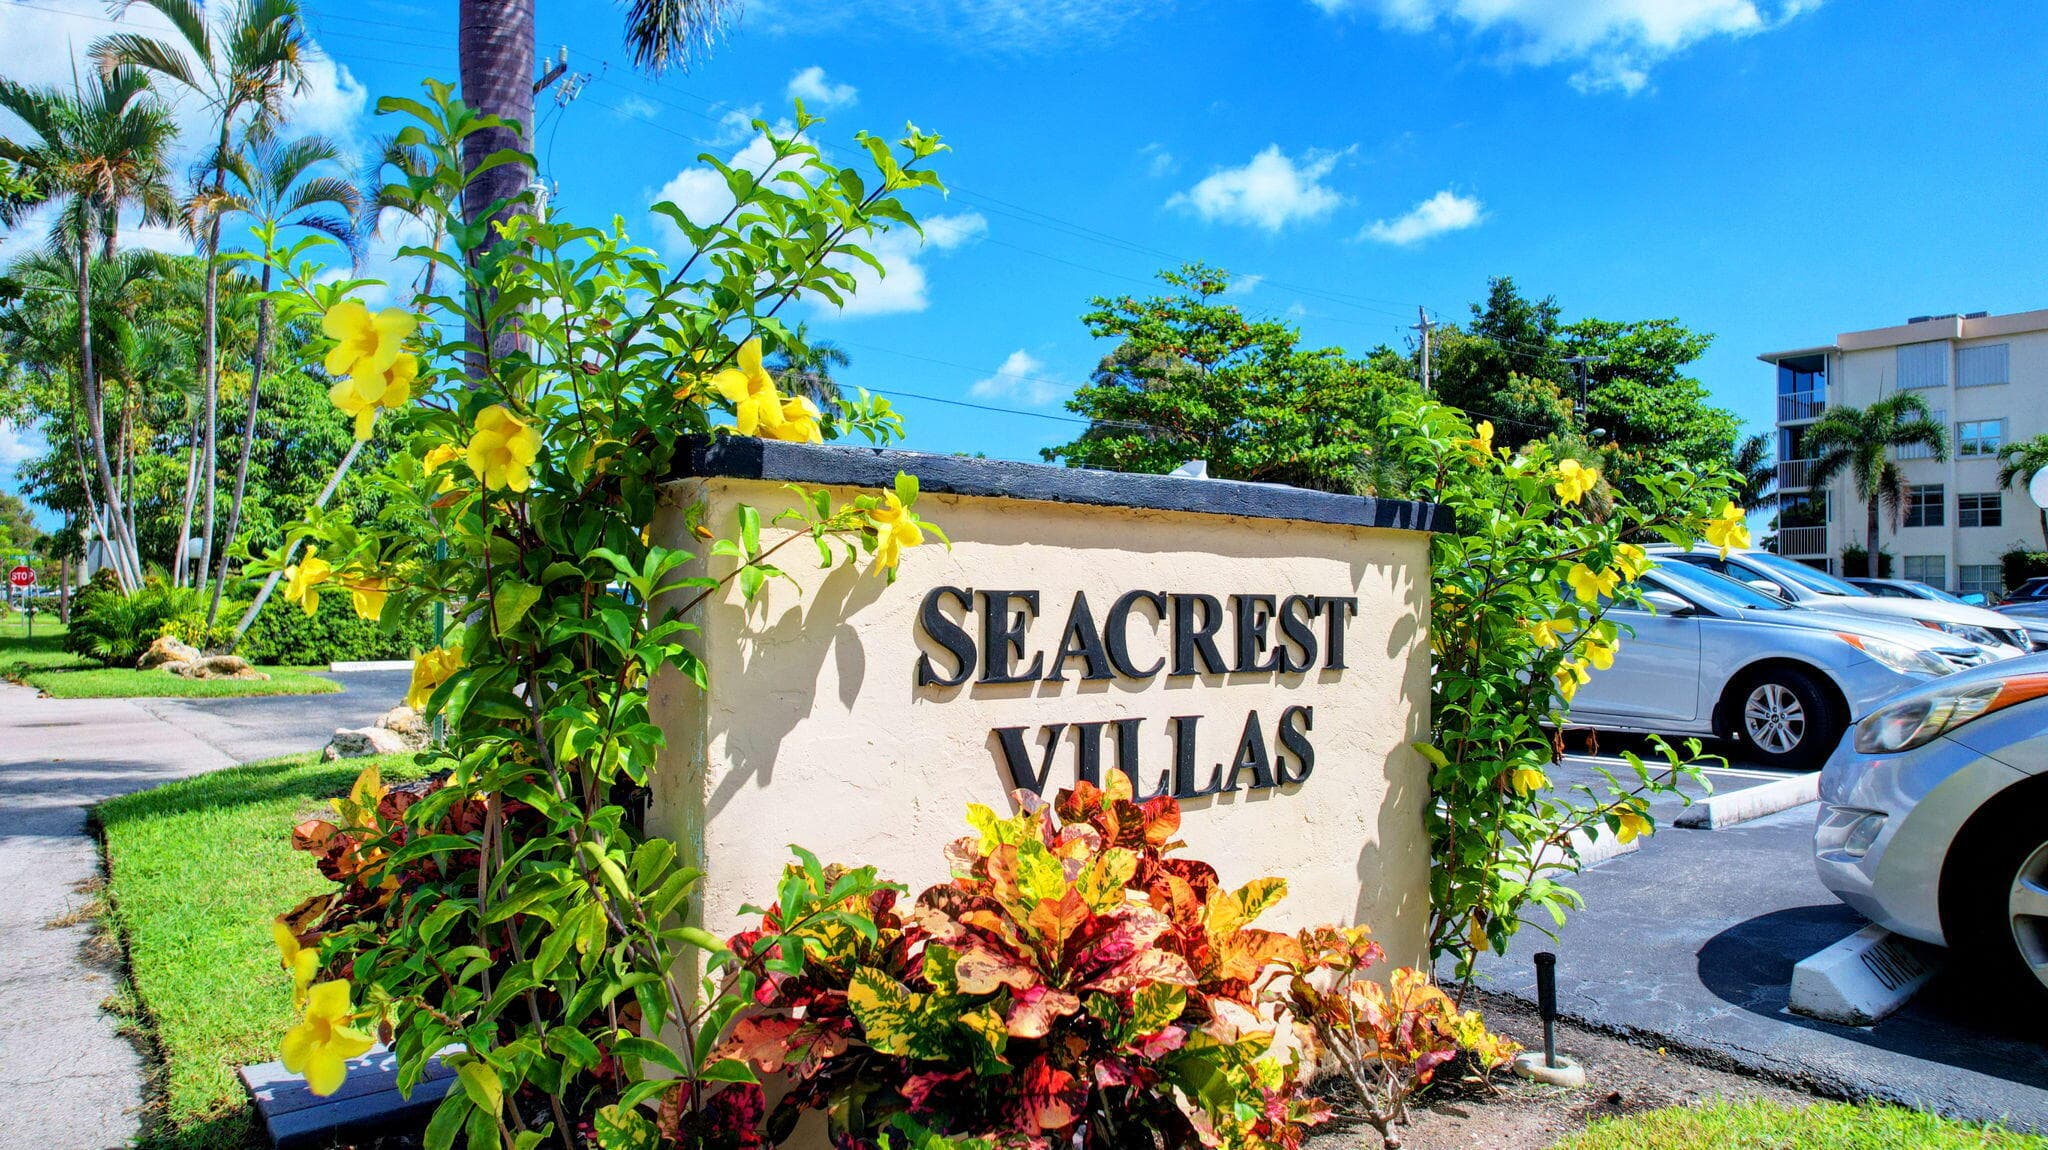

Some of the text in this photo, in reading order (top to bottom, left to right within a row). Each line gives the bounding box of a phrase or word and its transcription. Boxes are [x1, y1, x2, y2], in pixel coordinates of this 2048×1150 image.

[11, 571, 34, 581] STOP
[917, 585, 1358, 688] SEACREST
[991, 704, 1315, 804] VILLAS
